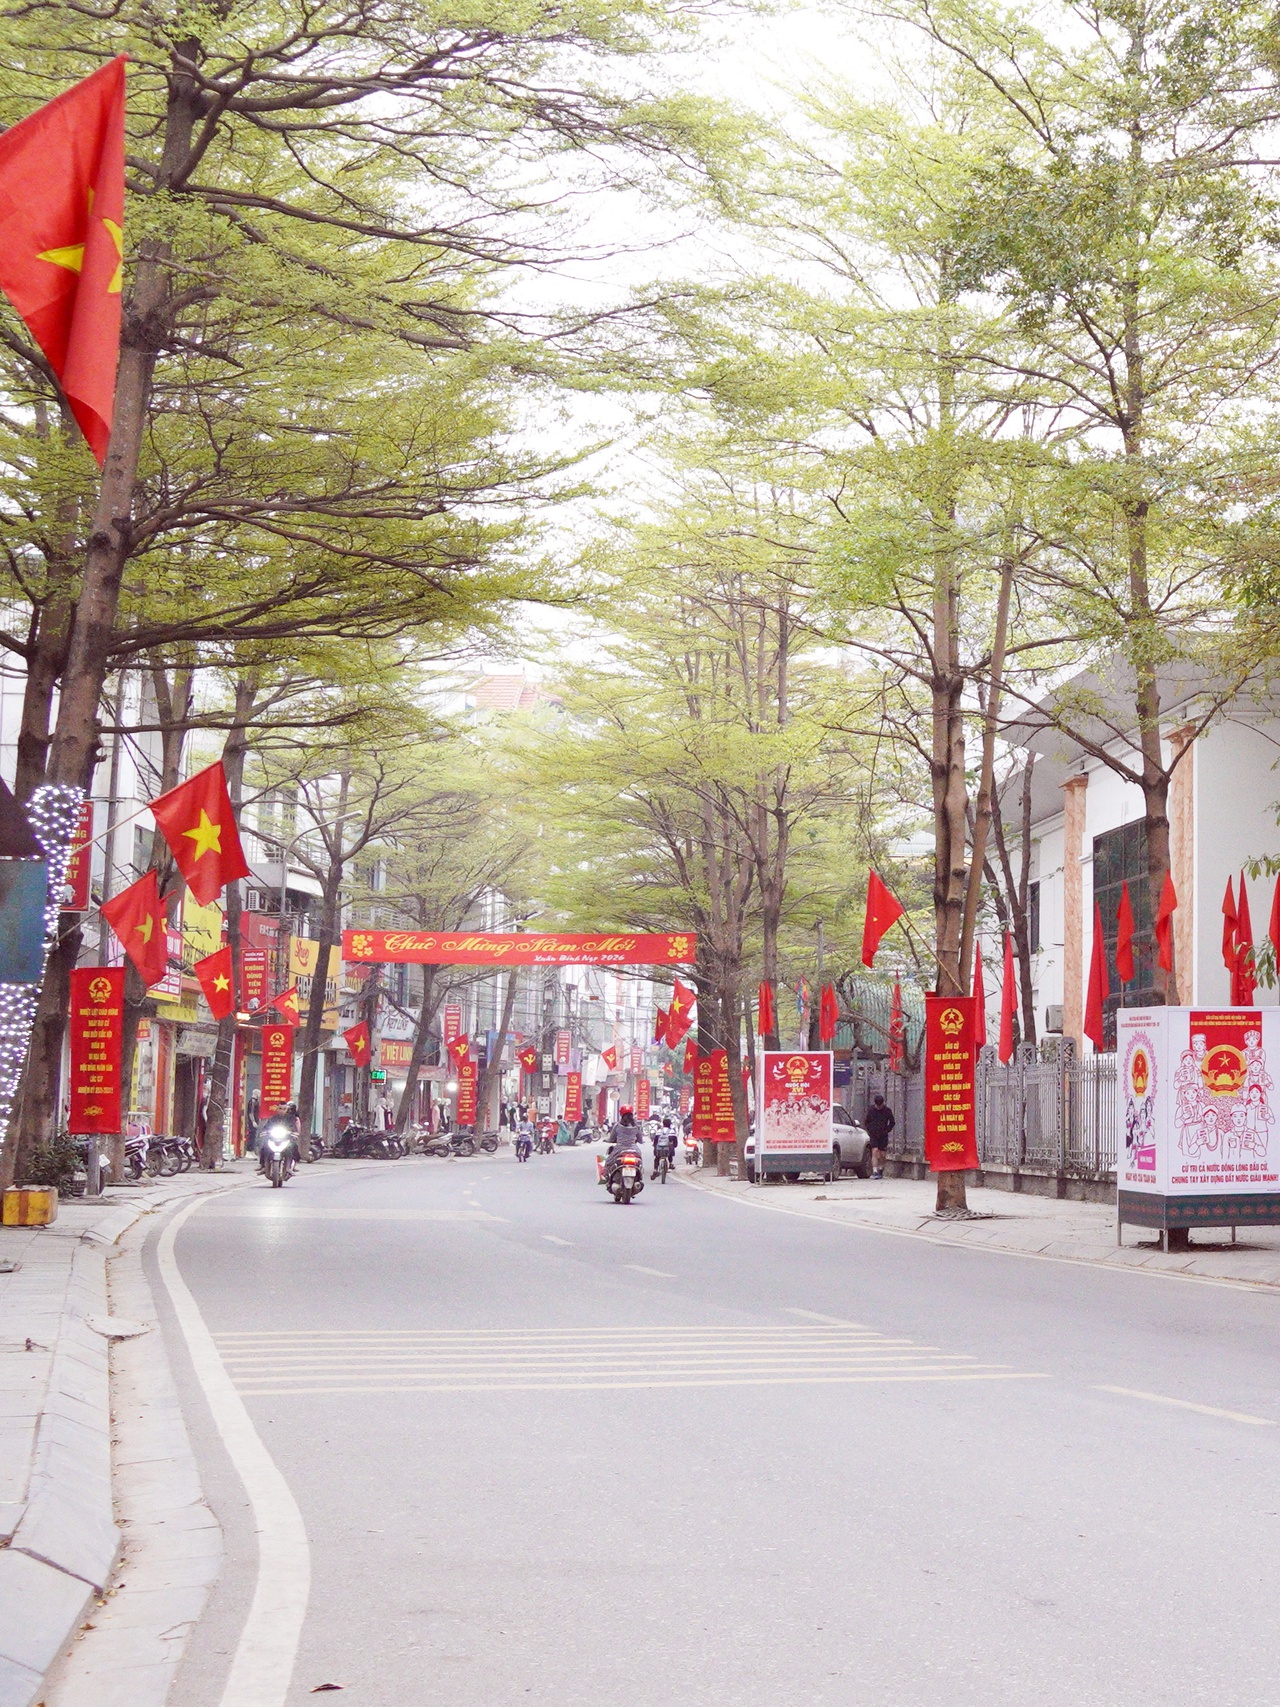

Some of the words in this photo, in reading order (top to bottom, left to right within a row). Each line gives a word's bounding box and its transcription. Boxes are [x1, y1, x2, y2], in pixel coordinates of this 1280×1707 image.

[441, 937, 515, 957] Mừng
[516, 938, 580, 952] Năm
[582, 938, 636, 952] Mới
